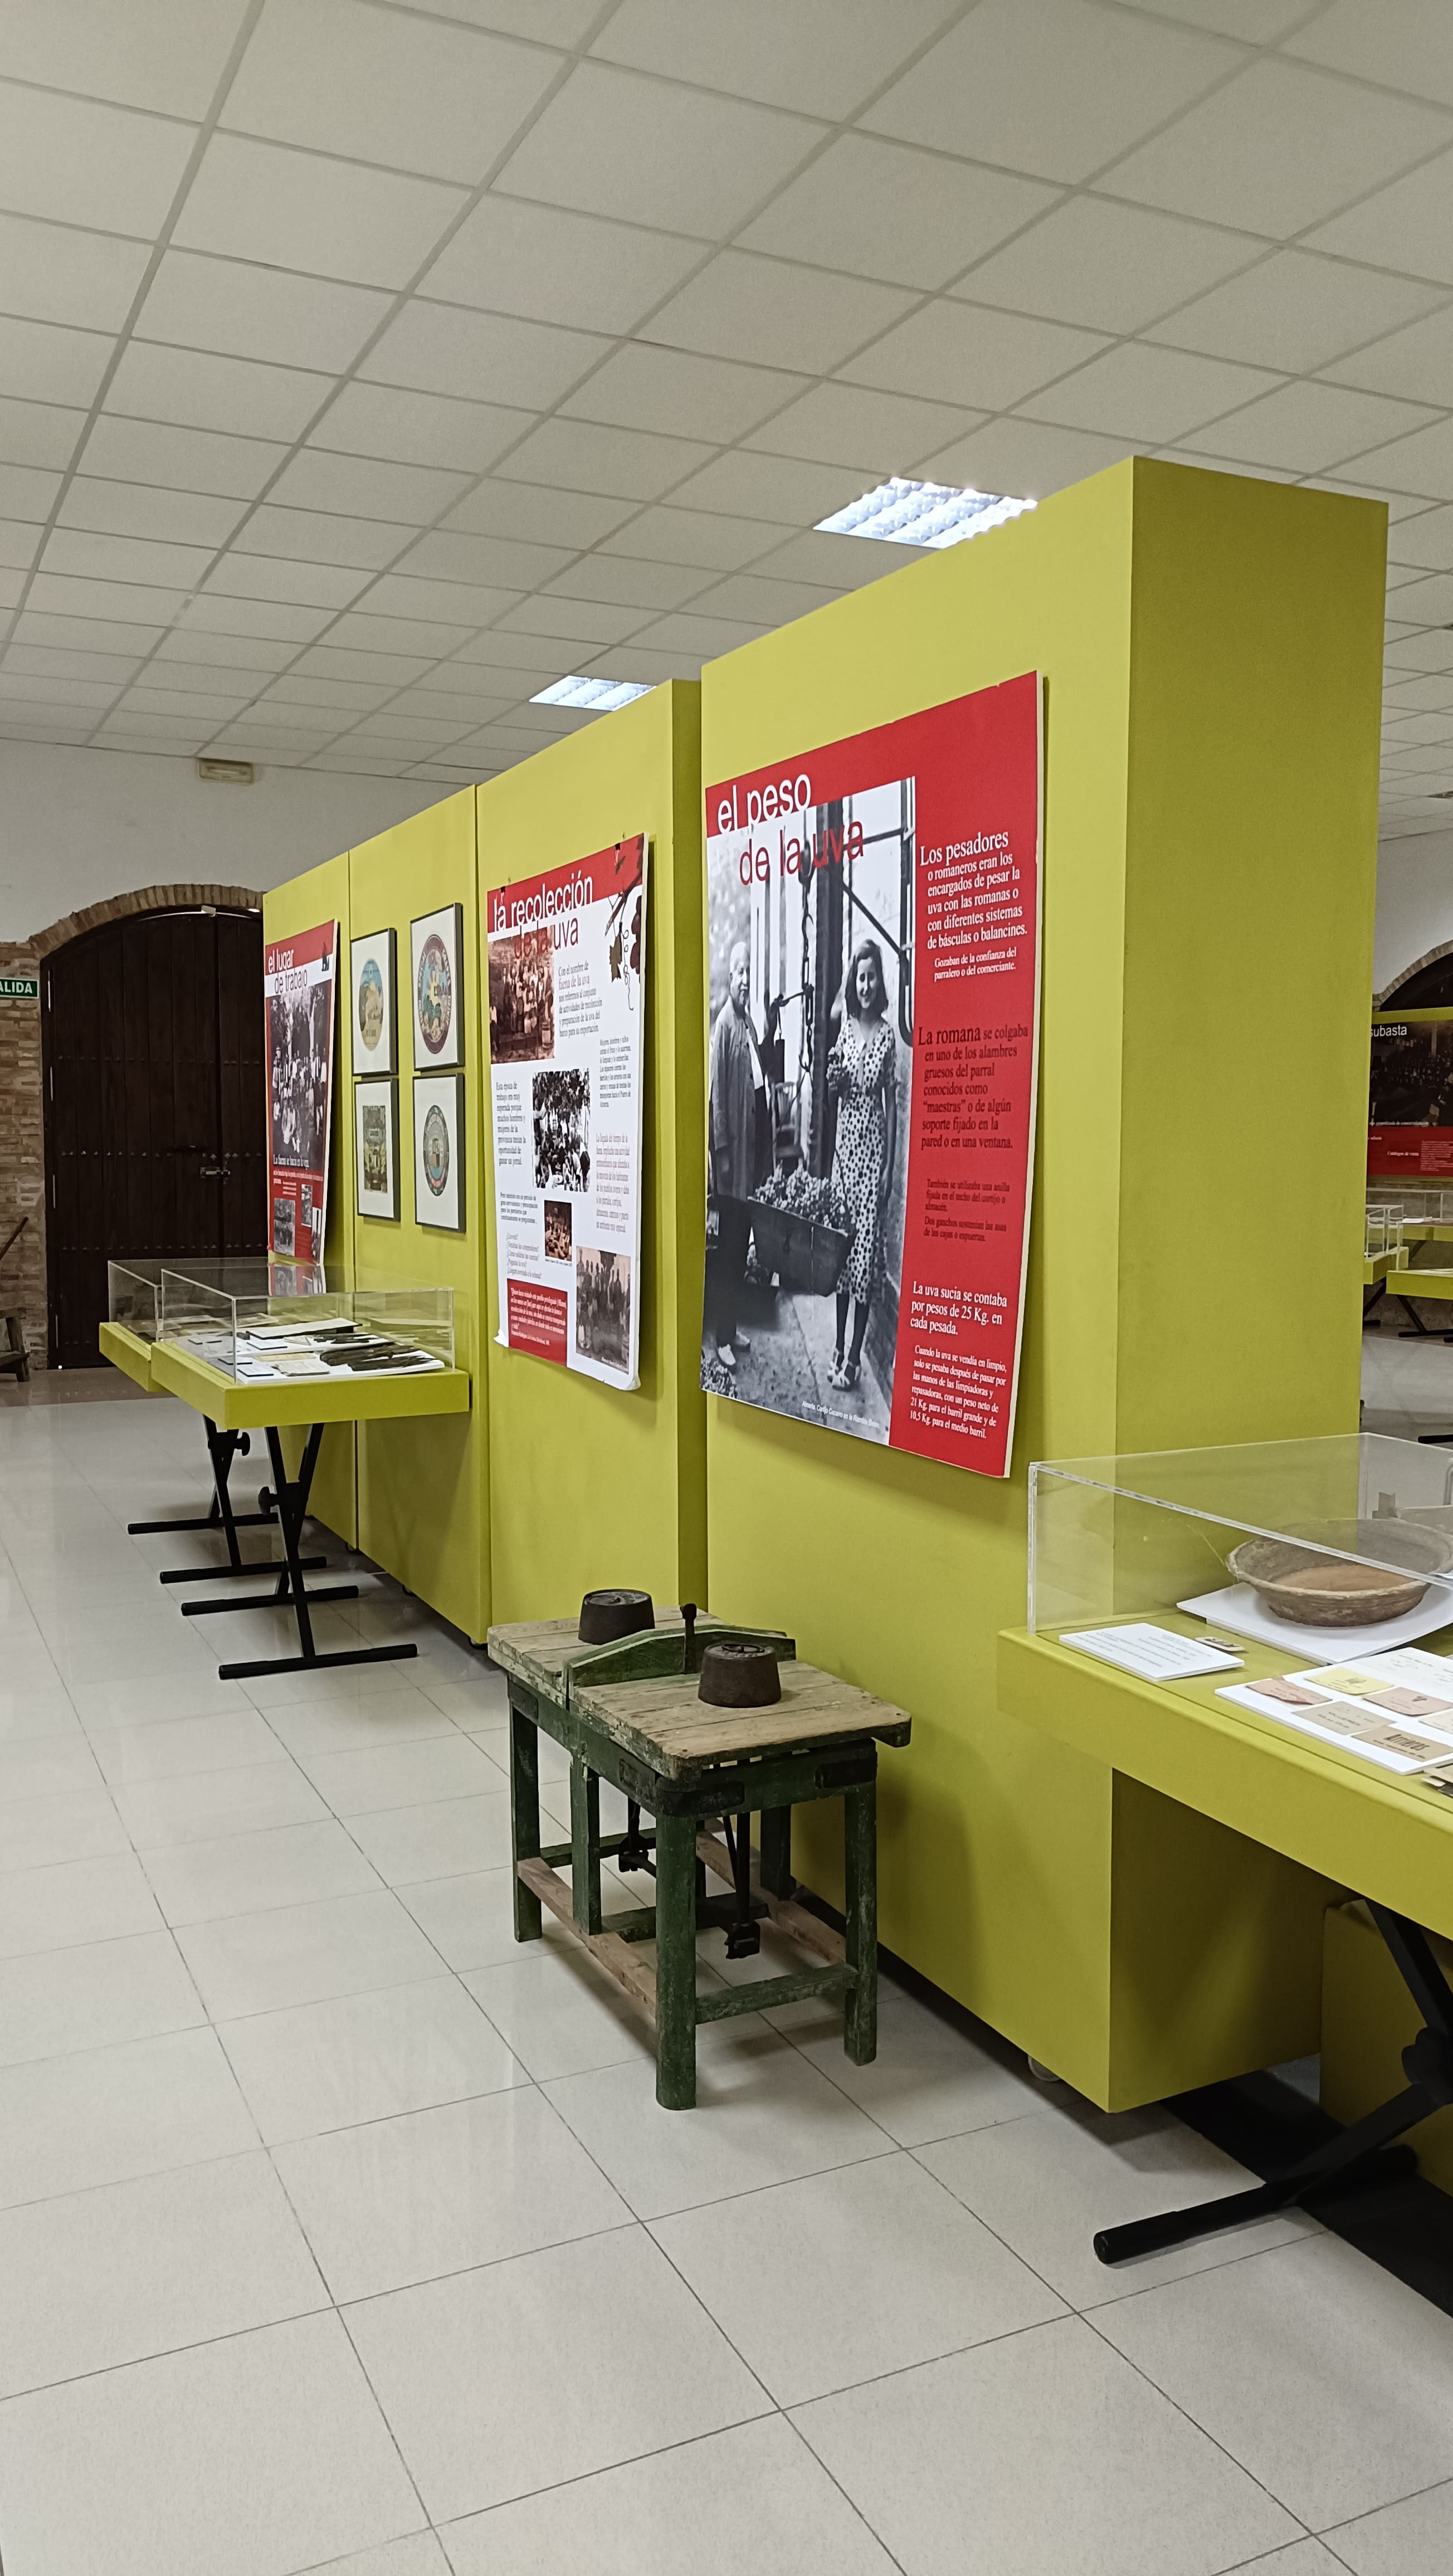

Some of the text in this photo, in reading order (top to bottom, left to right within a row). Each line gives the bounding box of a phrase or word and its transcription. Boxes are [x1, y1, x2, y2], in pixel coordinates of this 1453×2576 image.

[718, 774, 811, 835] el peso
[740, 821, 864, 886] de la uva
[920, 832, 1008, 865] Los pesadores
[928, 852, 1012, 881] o romaneros eran los
[928, 866, 1020, 896] encargados de pesar la
[494, 870, 593, 931] la recolección
[928, 888, 1018, 914] uva con las romanas o
[928, 906, 1022, 931] con diferentes sistemas
[514, 918, 578, 959] de la uva
[928, 923, 1027, 949] de básculas o balancines.
[269, 948, 294, 974] el lugar
[935, 947, 1016, 968] Gozaban de la confianza del
[275, 965, 307, 994] de trabajo
[934, 961, 1016, 982] parralero o del comerciante.
[918, 1023, 1028, 1045] La romana se colgaba
[925, 1044, 1017, 1061] en uno de los alambres
[924, 1062, 994, 1082] gruesos del parral
[924, 1082, 988, 1096] conocidos como
[968, 1102, 973, 1112] o
[976, 1099, 985, 1112] de
[988, 1098, 1011, 1115] algún
[922, 1116, 998, 1133] soporte fijado en la
[921, 1135, 1012, 1150] pared o en una ventana.
[913, 1281, 1007, 1307] La uva sucia se contaba
[910, 1316, 958, 1335] cada pesada.
[911, 1301, 1002, 1325] por pesos de 25 Kg. en
[915, 1345, 934, 1357] Cuando
[936, 1349, 940, 1358] la
[942, 1353, 950, 1361] uva
[959, 1355, 977, 1365] vendía
[987, 1359, 1007, 1373] limpio,
[914, 1359, 924, 1368] solo
[932, 1364, 949, 1373] pesaba
[950, 1366, 971, 1379] después
[972, 1370, 978, 1380] de
[979, 1374, 995, 1383] pasar
[996, 1377, 1006, 1387] por
[921, 1376, 938, 1385] manos
[939, 1377, 945, 1387] de
[955, 1382, 988, 1396] limpiadoras
[989, 1389, 993, 1399] y
[910, 1397, 916, 1407] 21
[929, 1404, 940, 1412] para
[942, 1404, 947, 1414] el
[963, 1411, 983, 1423] grande
[984, 1417, 988, 1427] y
[989, 1417, 997, 1426] de
[944, 1393, 954, 1402] con
[963, 1399, 976, 1408] peso
[978, 1401, 990, 1411] neto
[992, 1403, 998, 1413] de
[932, 1418, 944, 1427] para
[945, 1420, 950, 1428] el
[951, 1422, 968, 1434] medio
